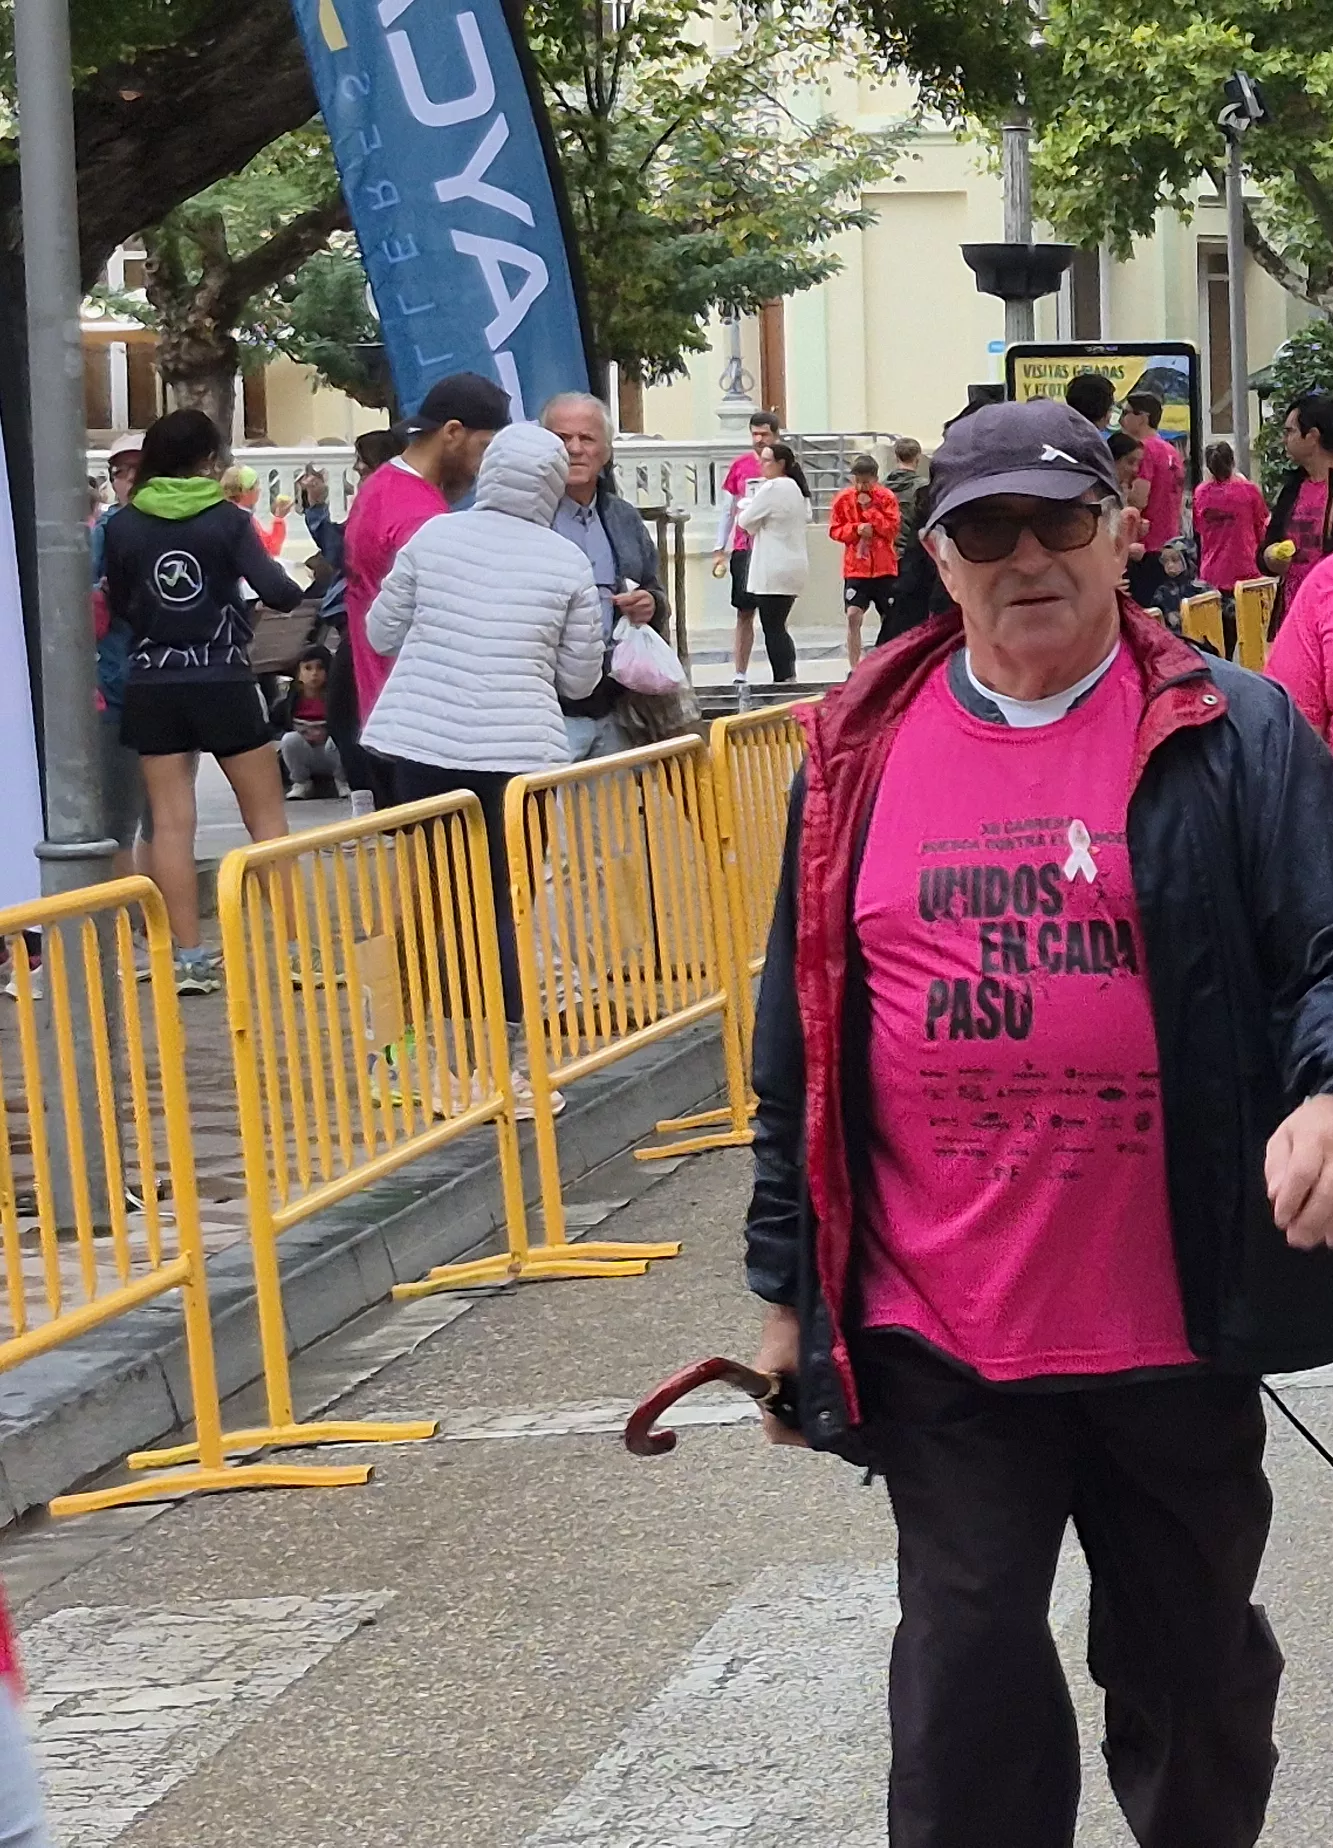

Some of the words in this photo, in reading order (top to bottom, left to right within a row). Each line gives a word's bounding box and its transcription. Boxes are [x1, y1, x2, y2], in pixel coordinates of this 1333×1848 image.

[1023, 364, 1069, 378] VISITAS
[1023, 383, 1032, 396] Y
[919, 863, 1063, 921] UNIDOS
[980, 921, 1034, 975] EN
[1038, 918, 1140, 975] CADA
[926, 976, 1034, 1041] PASO
